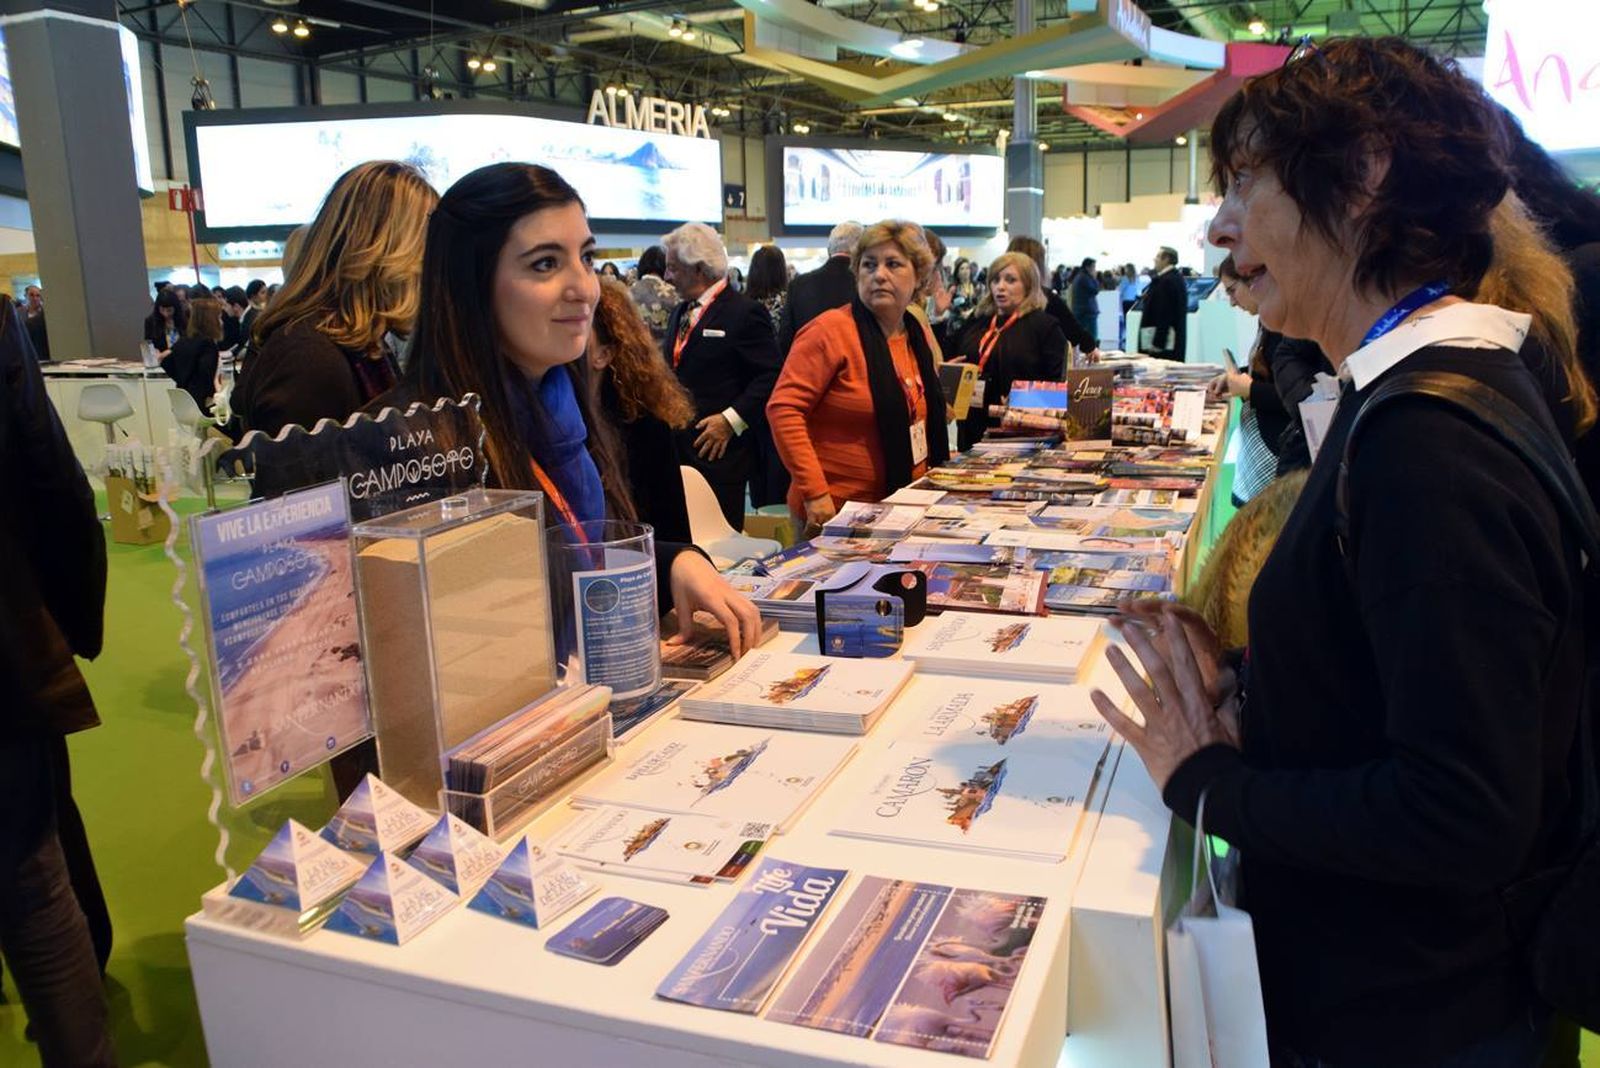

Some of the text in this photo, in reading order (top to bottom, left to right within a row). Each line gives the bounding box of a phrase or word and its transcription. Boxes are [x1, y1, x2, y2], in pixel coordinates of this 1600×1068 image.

[389, 429, 435, 452] PLAYA
[216, 494, 333, 543] VIVE LA EXPERIENCIA
[760, 876, 837, 938] Vida
